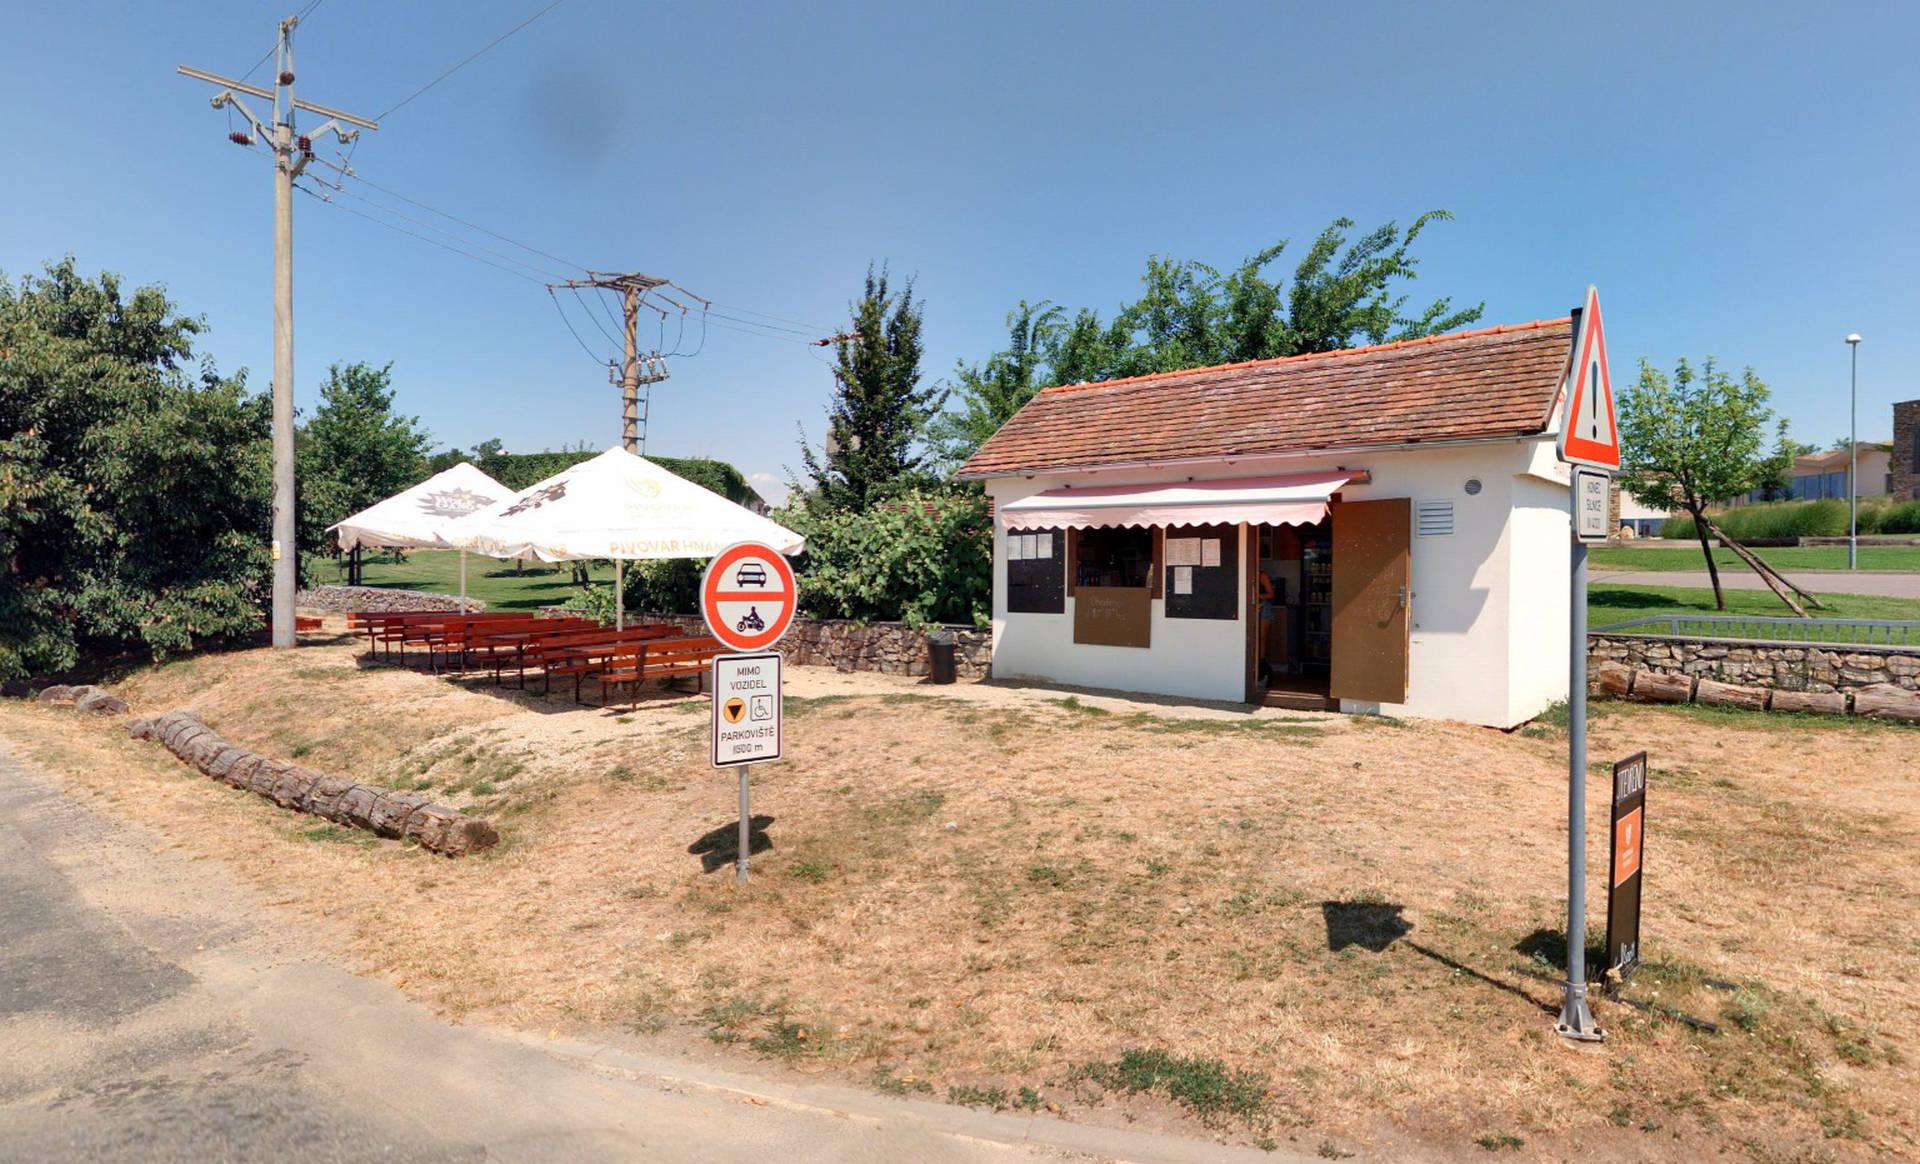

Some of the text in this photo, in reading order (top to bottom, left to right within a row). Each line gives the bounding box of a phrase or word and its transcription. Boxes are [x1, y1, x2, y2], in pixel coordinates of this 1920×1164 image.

[609, 539, 722, 554] PIVOVAR HNAN
[736, 665, 761, 677] MIMO
[730, 679, 767, 691] VOZIDEL
[720, 726, 775, 742] PARKOVIŠTĚ
